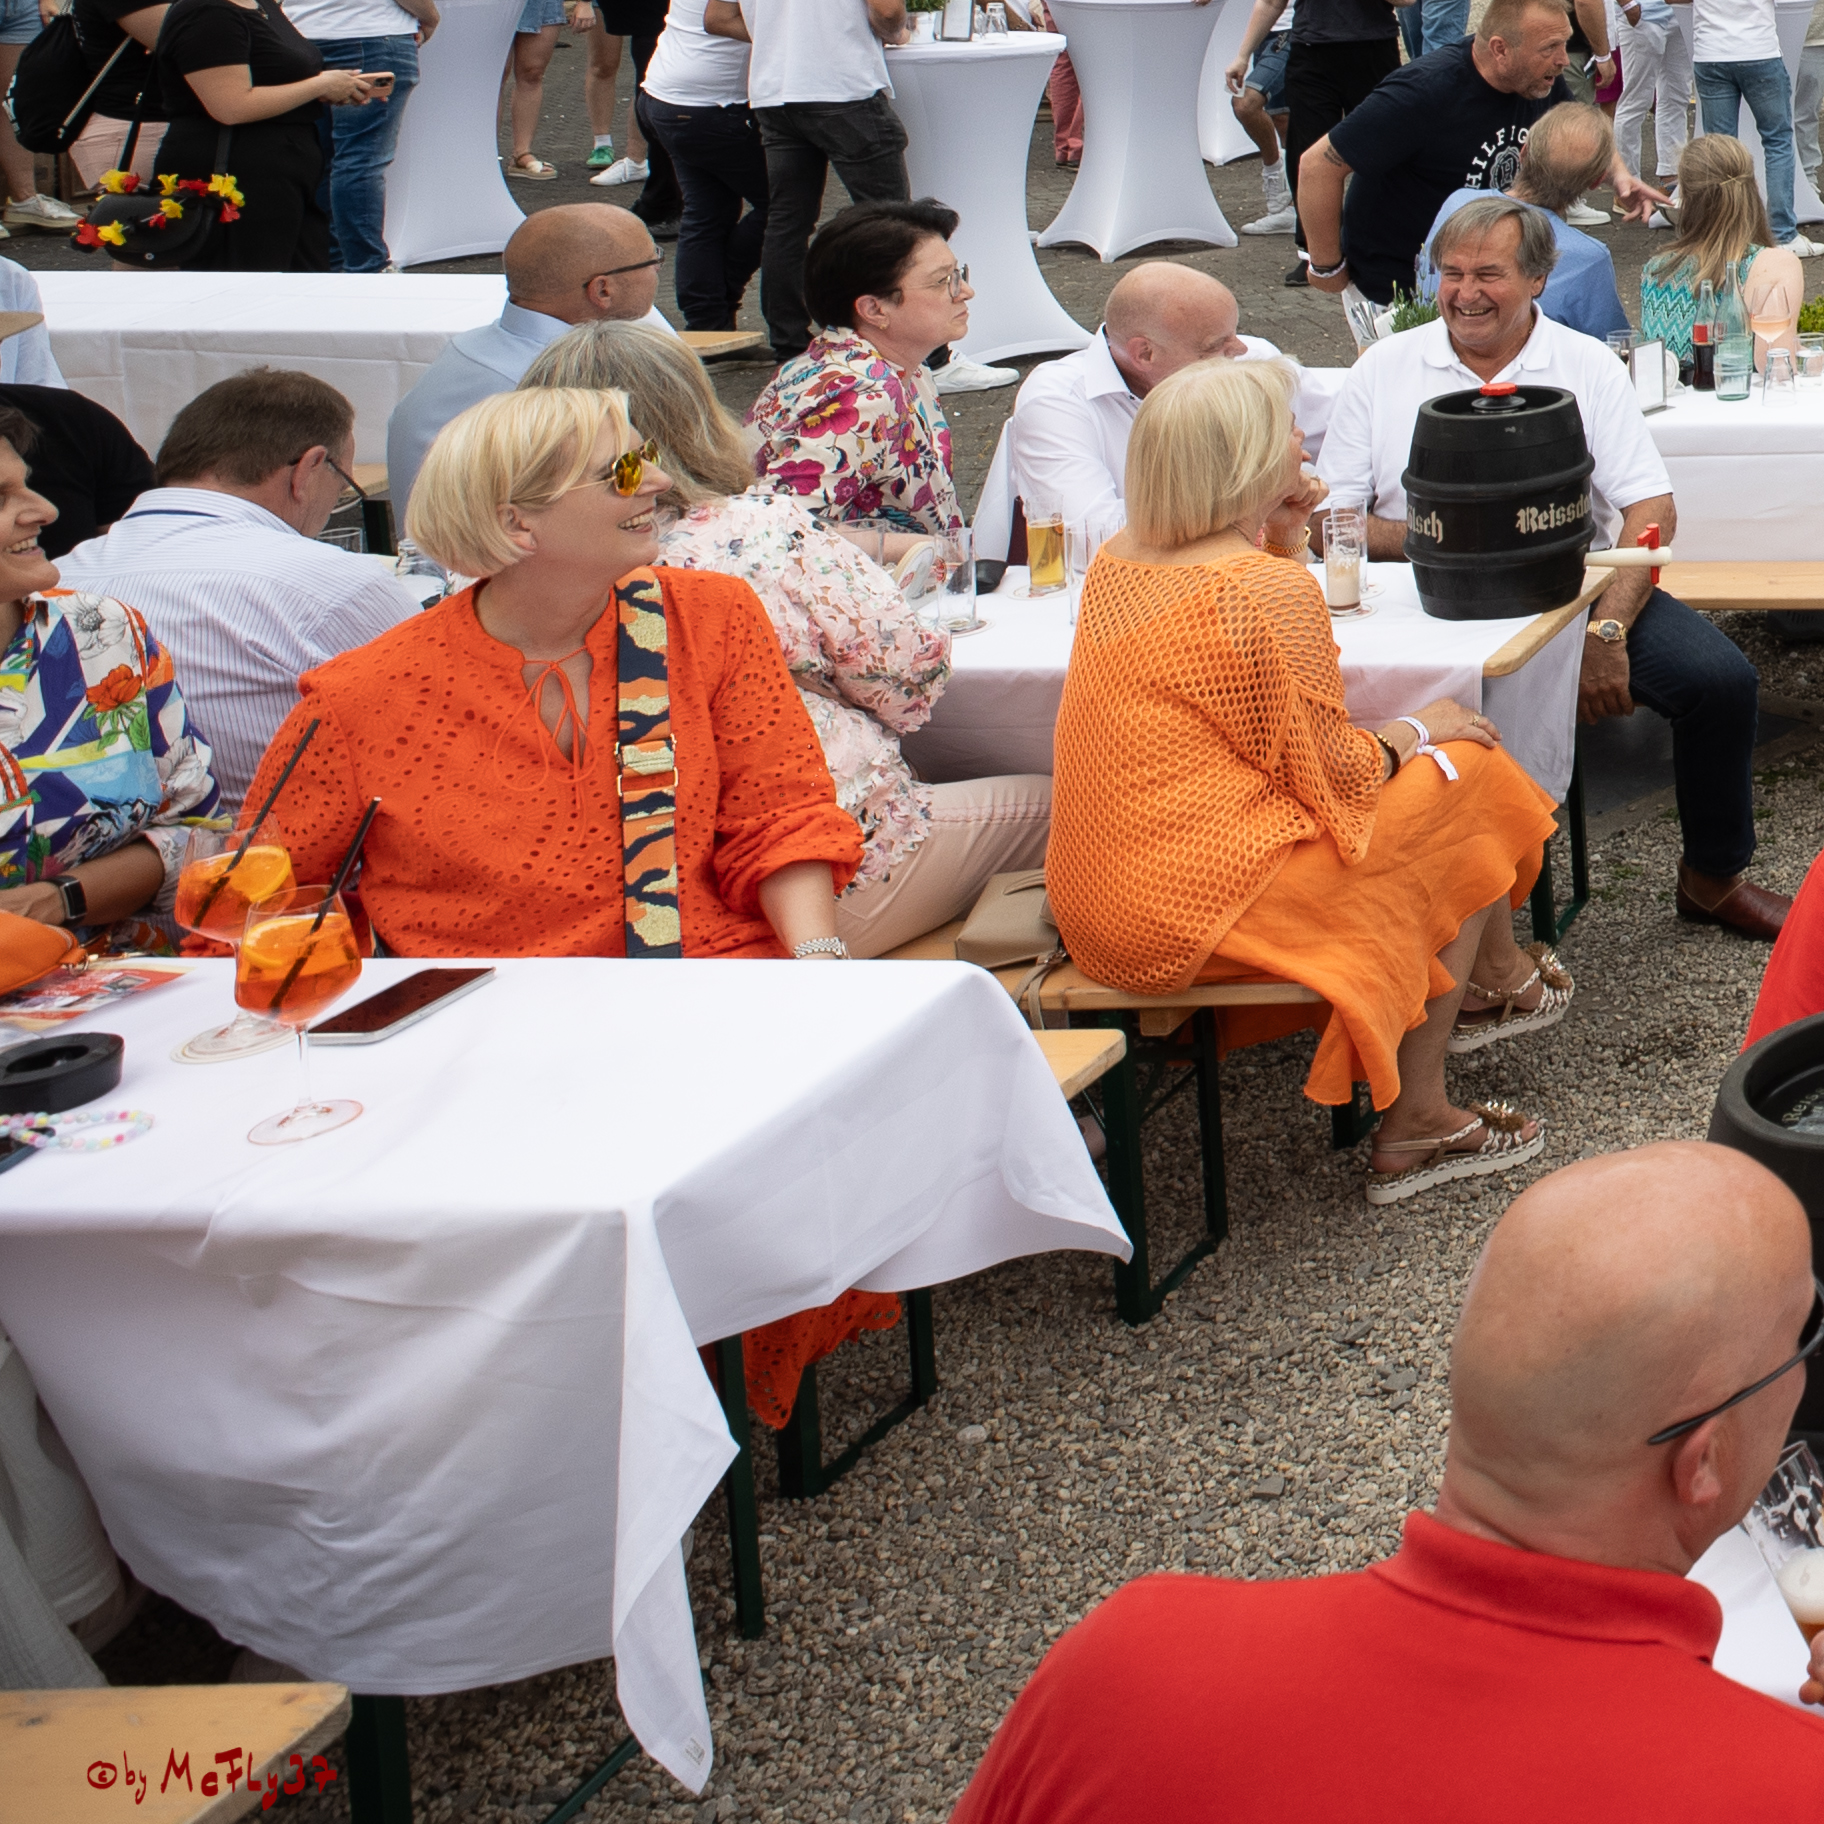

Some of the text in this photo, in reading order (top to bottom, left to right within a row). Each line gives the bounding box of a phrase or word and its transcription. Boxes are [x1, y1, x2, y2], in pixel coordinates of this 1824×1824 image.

[1464, 125, 1530, 190] HILFIG
[1406, 492, 1592, 544] Reissdo ölsch
